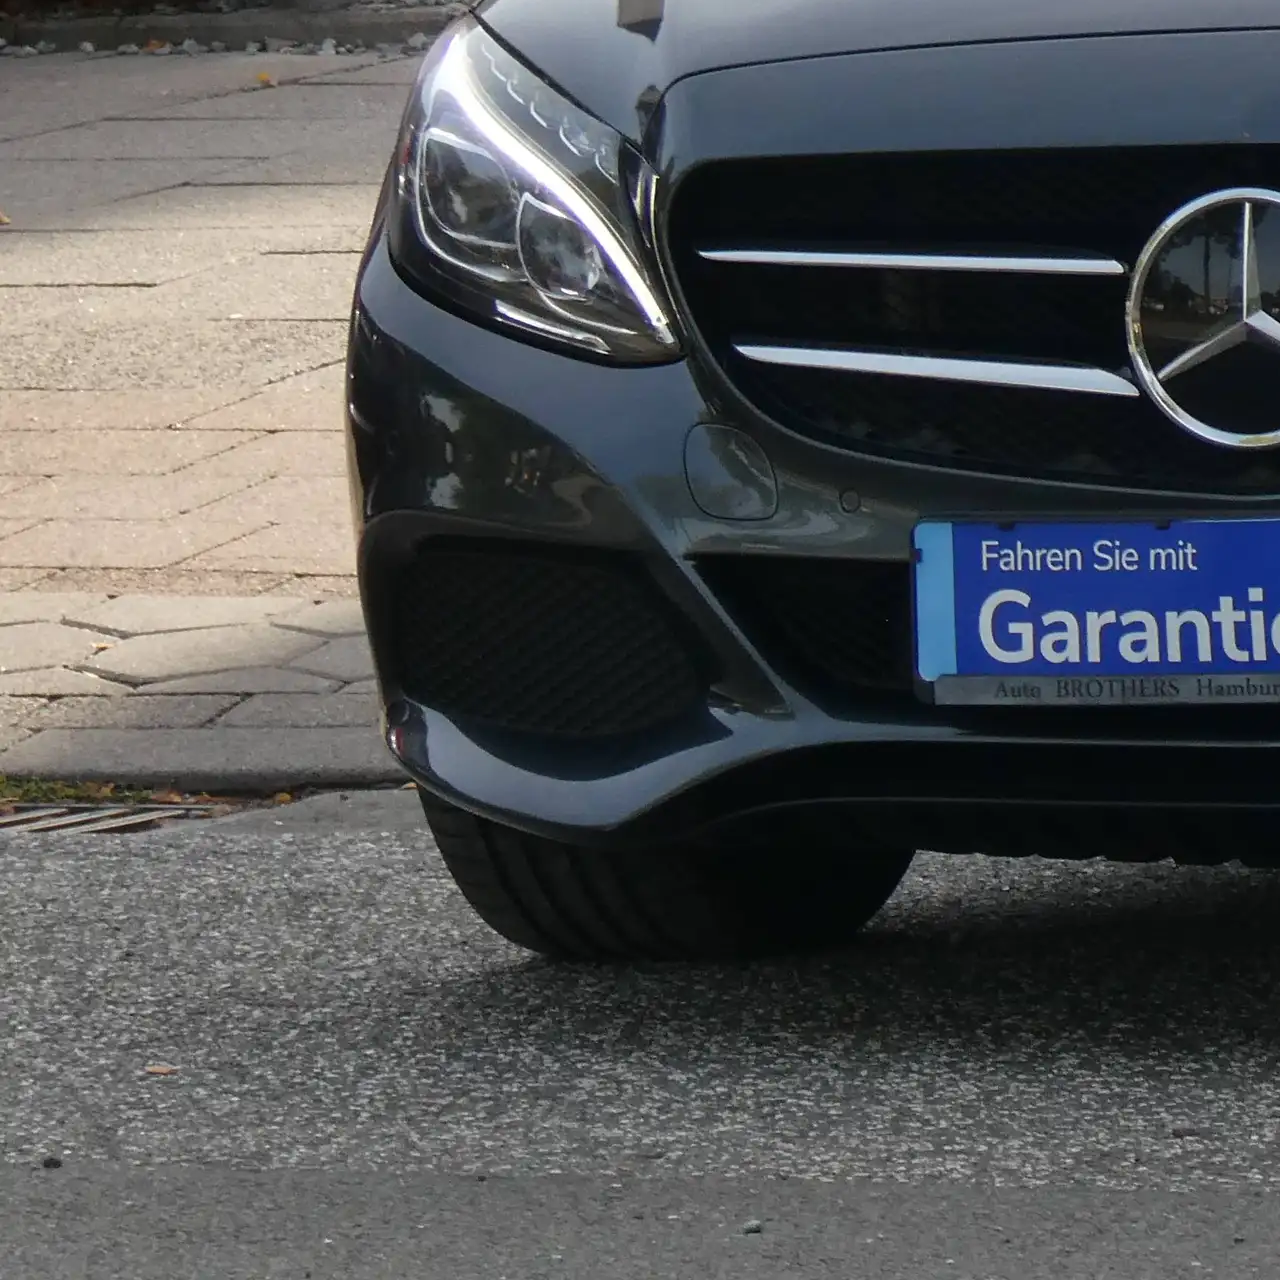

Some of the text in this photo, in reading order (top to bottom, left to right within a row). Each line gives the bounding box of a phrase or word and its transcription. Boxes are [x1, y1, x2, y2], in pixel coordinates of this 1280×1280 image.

[980, 540, 1198, 572] Fahren Sie mit
[994, 680, 1042, 700] Auto
[1055, 677, 1181, 700] BROTHERS
